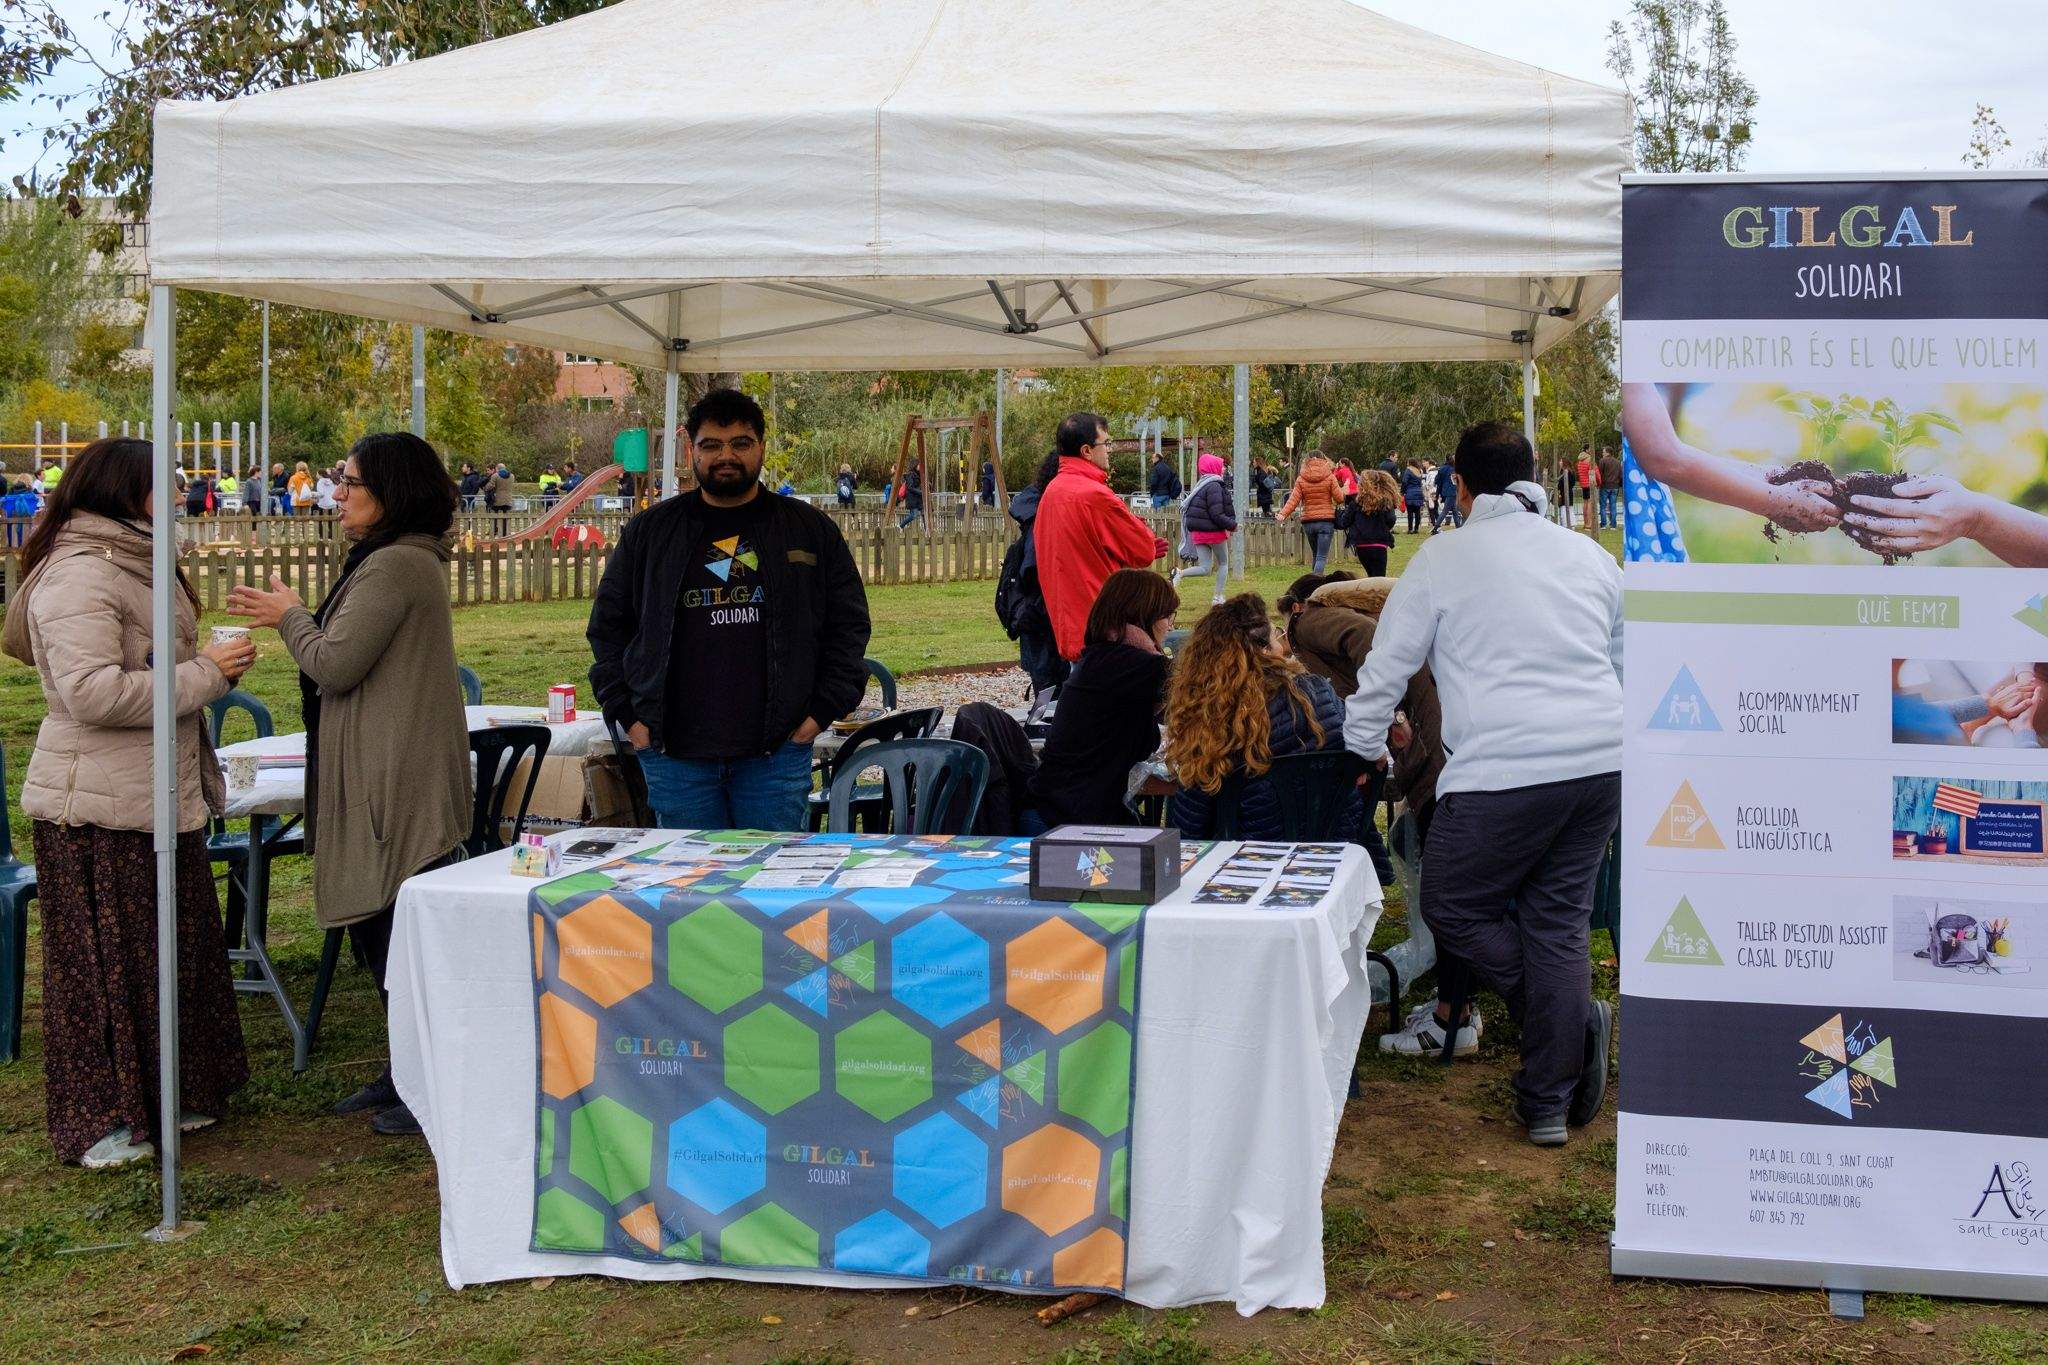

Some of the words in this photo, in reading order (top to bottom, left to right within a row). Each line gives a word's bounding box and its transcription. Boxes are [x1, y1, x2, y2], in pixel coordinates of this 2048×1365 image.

[1722, 205, 1974, 248] GILGAL
[1795, 262, 1902, 299] SOLIDARI
[1660, 335, 1793, 369] COMPARTIR
[1809, 331, 1834, 368] ÉS
[1851, 337, 1874, 368] EL
[1891, 335, 1939, 370] QUE
[1955, 336, 2037, 368] VOLEM
[683, 585, 765, 608] GILGA
[710, 606, 759, 625] SOLIDARI
[1857, 595, 1891, 625] QUÈ
[1902, 600, 1948, 625] FEM?
[1738, 690, 1860, 713] ACOMPANYAMENT
[1738, 714, 1787, 734] SOCIAL
[1737, 806, 1799, 829] ACOLLIDA
[1736, 825, 1832, 853] LLINGÜÍSTICA
[1737, 921, 1777, 943] TALLER
[1783, 922, 1834, 944] D'ESTUDI
[1839, 925, 1888, 946] ASSISTIT
[1737, 947, 1777, 969] CASAL
[1785, 948, 1833, 970] D'ESTIU
[898, 963, 983, 977] gilgalsolidari.org
[1011, 968, 1100, 982] #GilgalSolidari
[615, 1036, 707, 1058] GILGAL
[639, 1060, 683, 1076] SOLIDARI
[841, 1059, 925, 1074] gilgalsolidari.org
[673, 1150, 764, 1164] #GilgalSolidari
[783, 1144, 875, 1167] GILGAL
[1646, 1142, 1690, 1157] DIRECCIÓ:
[1749, 1148, 1776, 1164] PLAÇA
[1780, 1149, 1795, 1164] DEL
[1800, 1151, 1821, 1166] COLL
[1826, 1153, 1835, 1167] 9,
[1840, 1155, 1861, 1168] SANT
[1866, 1156, 1895, 1169] CUGAT
[807, 1168, 850, 1185] SOLIDARI
[1646, 1163, 1675, 1177] EMAIL:
[1749, 1169, 1874, 1189] AMBTU@GILGALSOLIDARI.ORG
[1646, 1183, 1669, 1197] WEB:
[1749, 1190, 1861, 1208] WWW.GILGALSOLIDARI.ORG
[1971, 1164, 2022, 1219] A
[1749, 1210, 1765, 1223] 607
[1769, 1210, 1785, 1224] 845
[1790, 1212, 1805, 1225] 792
[1958, 1223, 1999, 1238] sant
[2001, 1226, 2048, 1245] cugat
